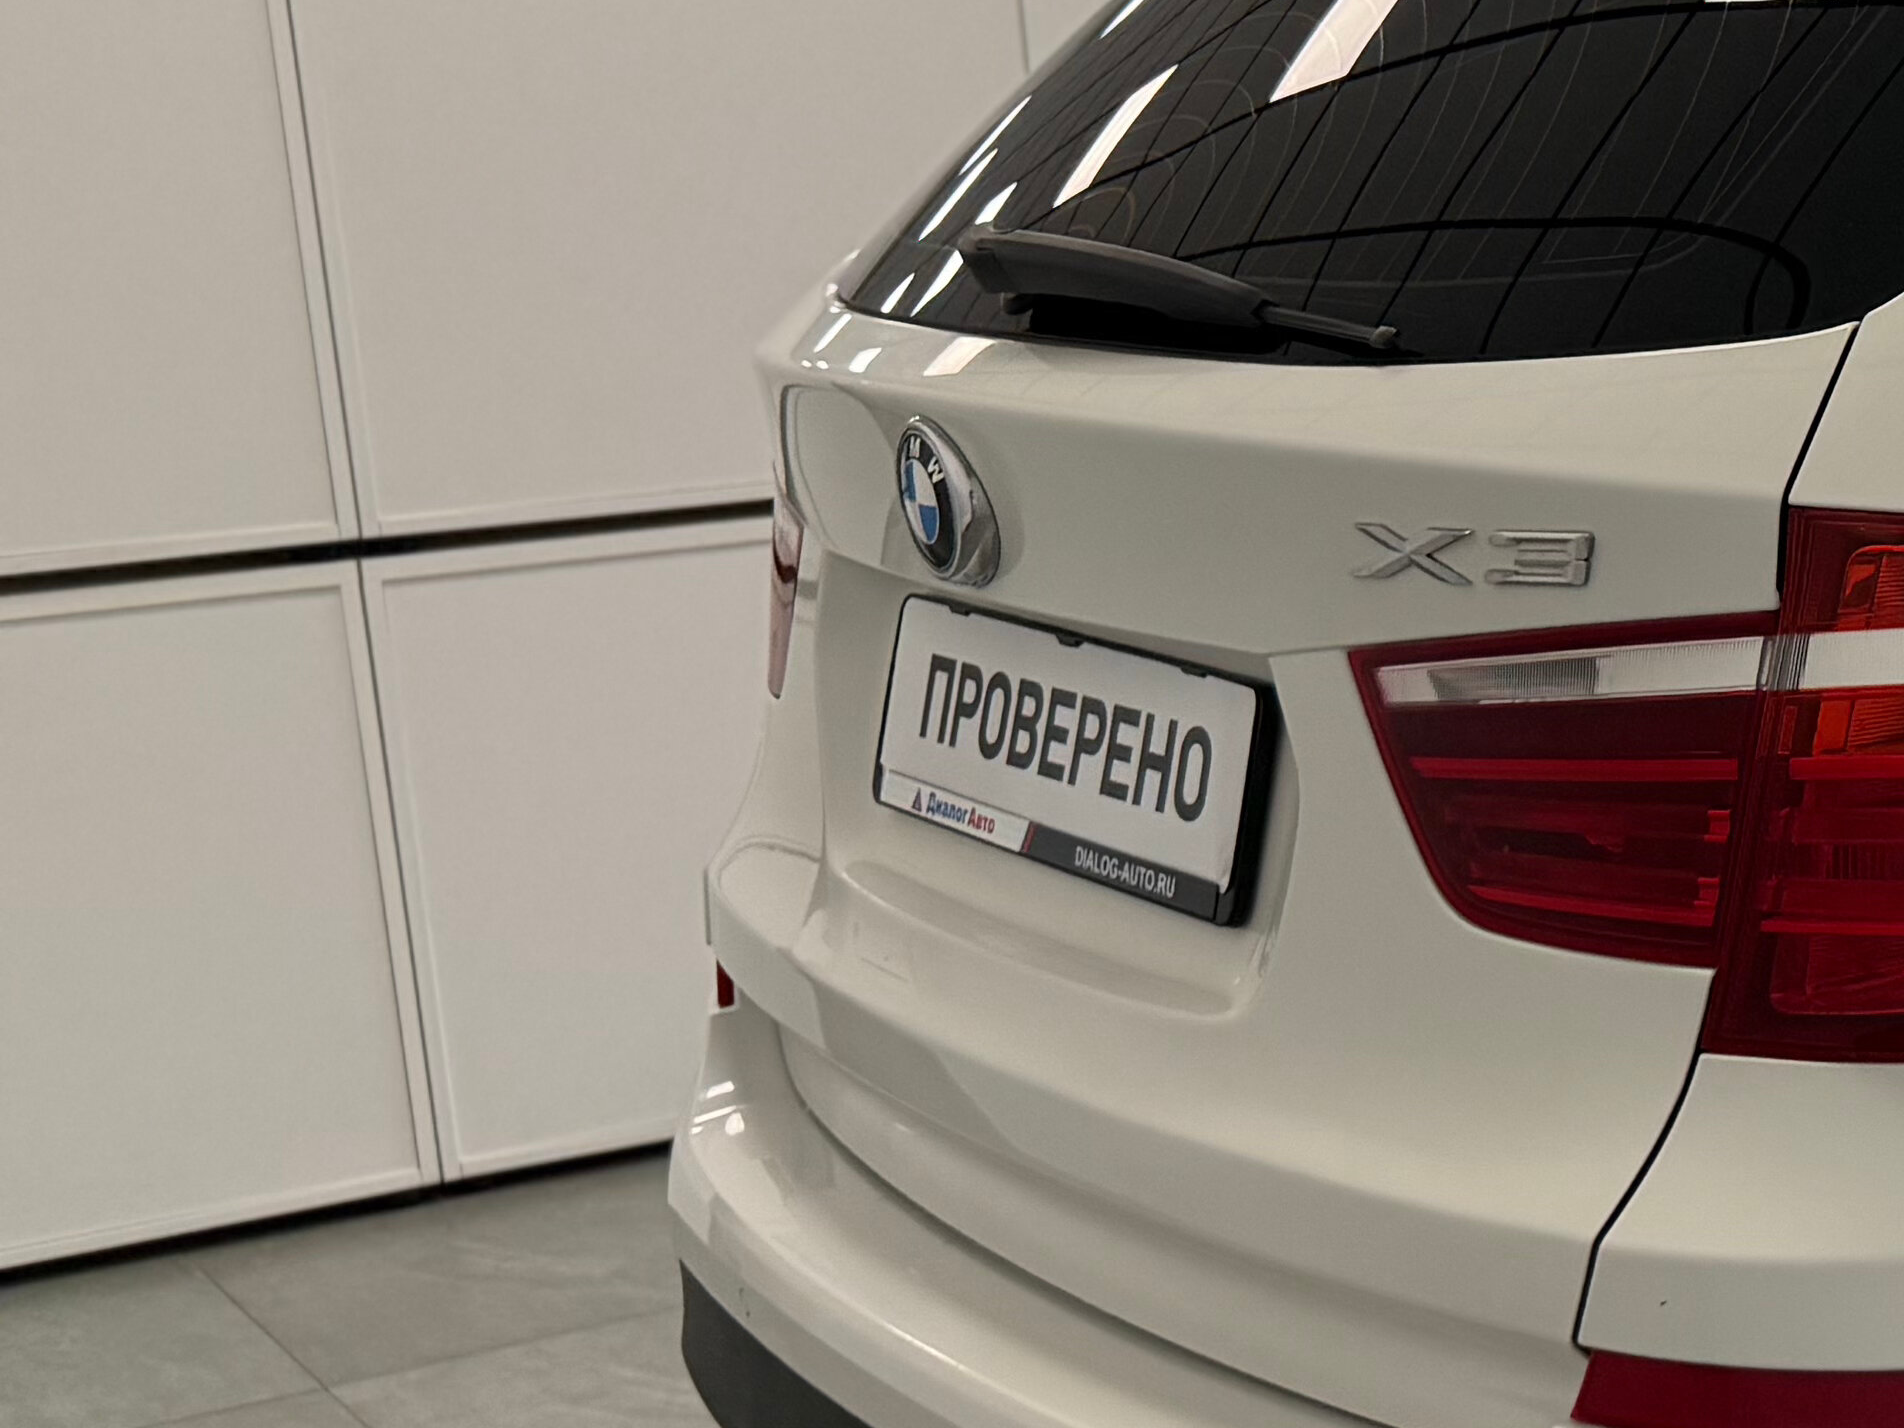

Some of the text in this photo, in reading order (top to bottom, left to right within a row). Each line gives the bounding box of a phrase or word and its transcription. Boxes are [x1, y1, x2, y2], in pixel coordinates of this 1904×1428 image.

[1351, 522, 1596, 587] X3
[919, 653, 1212, 822] ПРОВЕРЕНО
[1074, 845, 1176, 898] DIALOG-AUTO.RU
